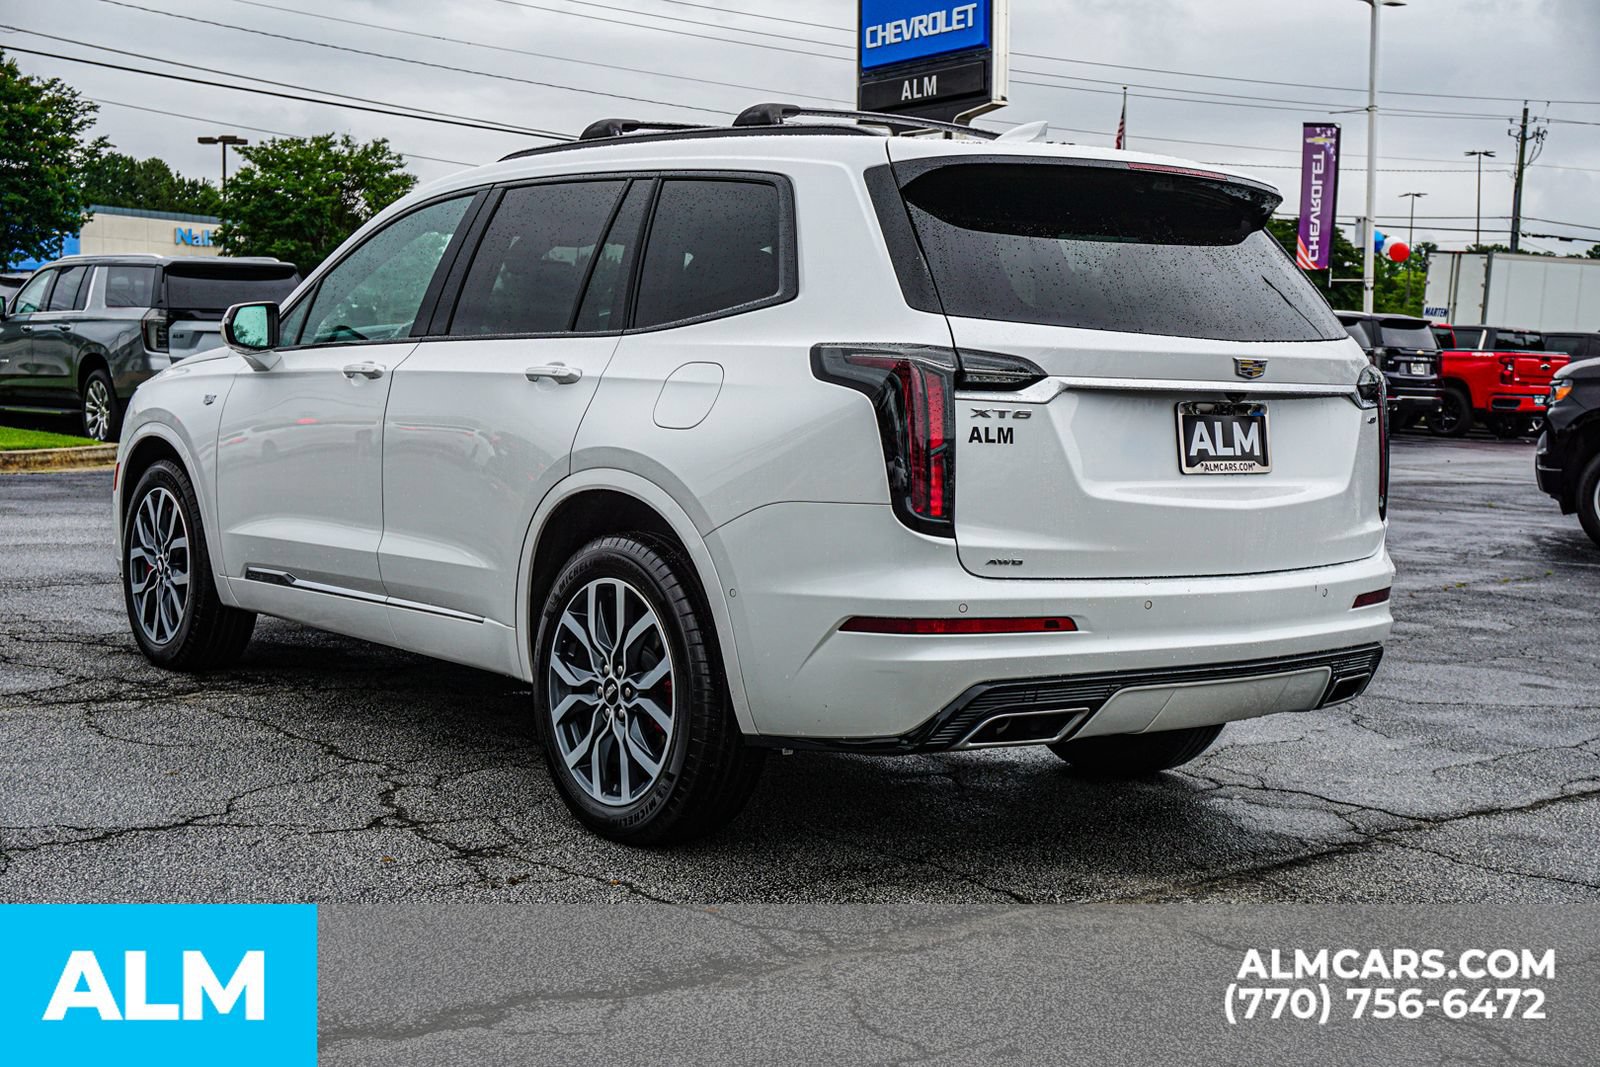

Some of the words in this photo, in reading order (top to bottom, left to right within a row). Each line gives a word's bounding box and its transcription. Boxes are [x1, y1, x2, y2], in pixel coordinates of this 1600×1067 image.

[866, 3, 977, 49] CHEVROLET
[901, 75, 937, 101] ALM
[1308, 151, 1325, 262] CHEVROLET
[970, 407, 1033, 420] XT6
[968, 426, 1014, 445] ALM
[1189, 421, 1260, 456] ALM
[985, 558, 1023, 566] AWD
